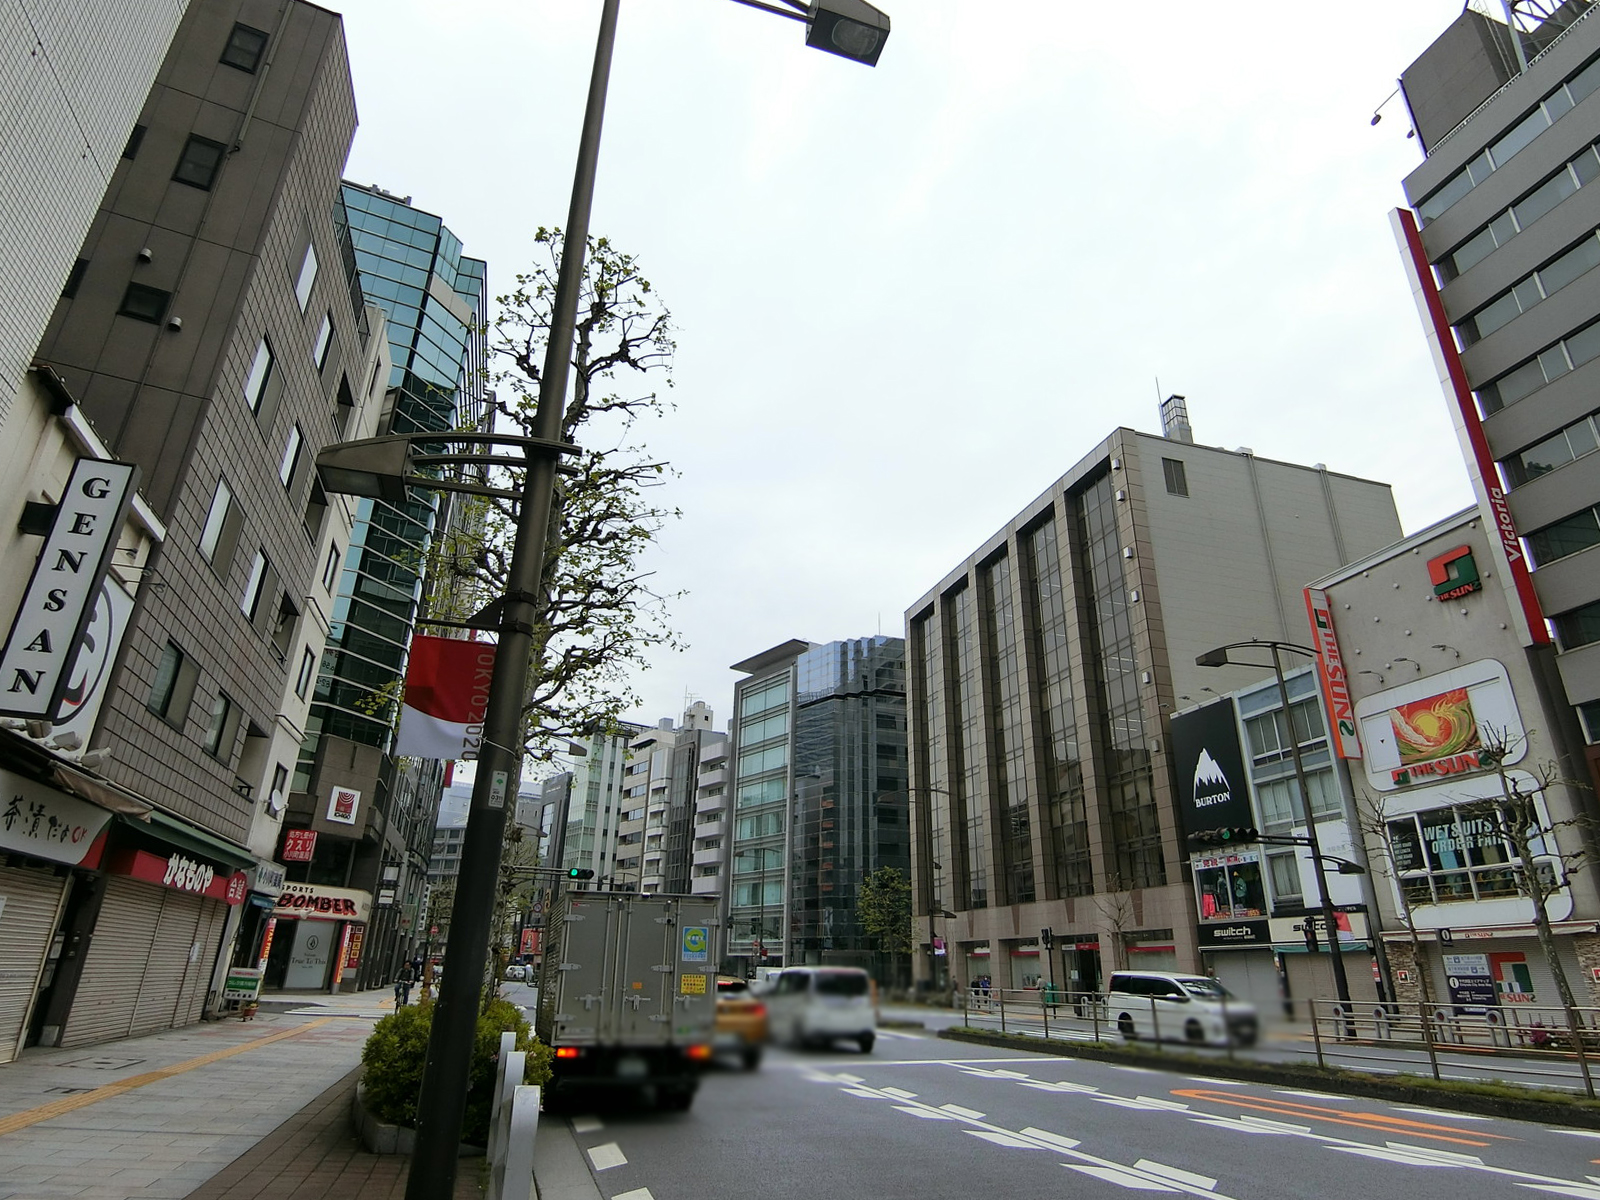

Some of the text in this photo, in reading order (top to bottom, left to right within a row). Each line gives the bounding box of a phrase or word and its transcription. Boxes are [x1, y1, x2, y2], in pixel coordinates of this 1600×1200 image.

[1491, 488, 1521, 562] Victoria
[7, 477, 111, 695] GENSAN
[461, 644, 497, 761] TOKYO 2020
[1195, 791, 1231, 808] BURTON
[286, 839, 313, 852] クスリ
[1432, 835, 1474, 854] ORDER
[282, 884, 314, 893] SPORTS
[277, 893, 357, 915] BOMBER
[1214, 926, 1251, 937] switch
